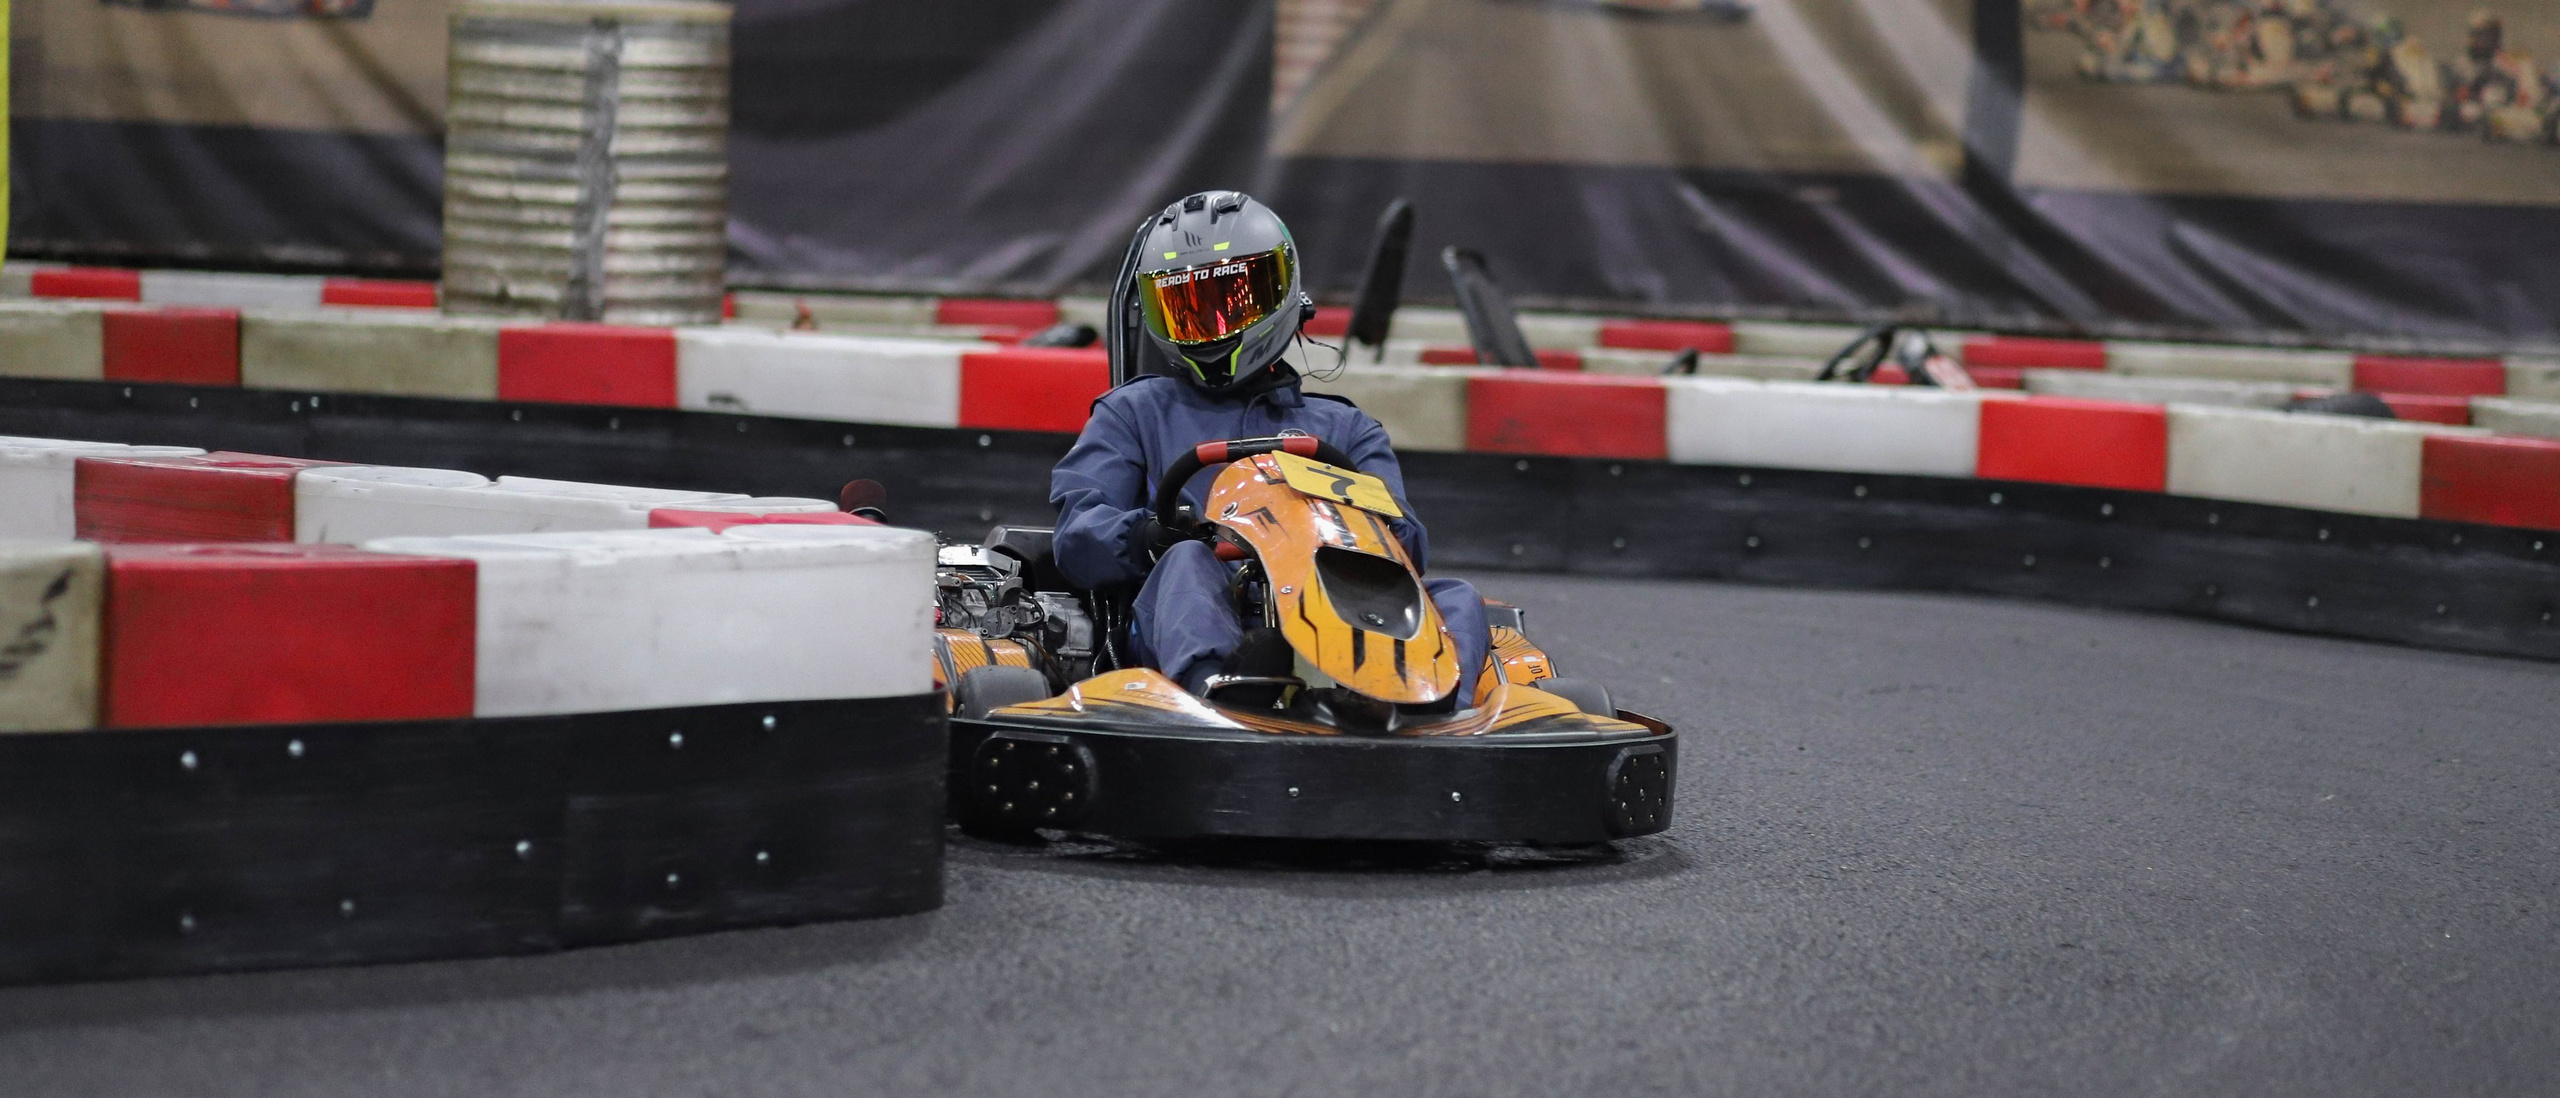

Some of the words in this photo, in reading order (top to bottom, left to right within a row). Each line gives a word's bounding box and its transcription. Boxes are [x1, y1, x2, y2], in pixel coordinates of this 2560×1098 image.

[1156, 273, 1190, 289] READY
[1193, 269, 1209, 281] TO
[1213, 262, 1247, 277] RACE
[1306, 466, 1356, 498] 7
